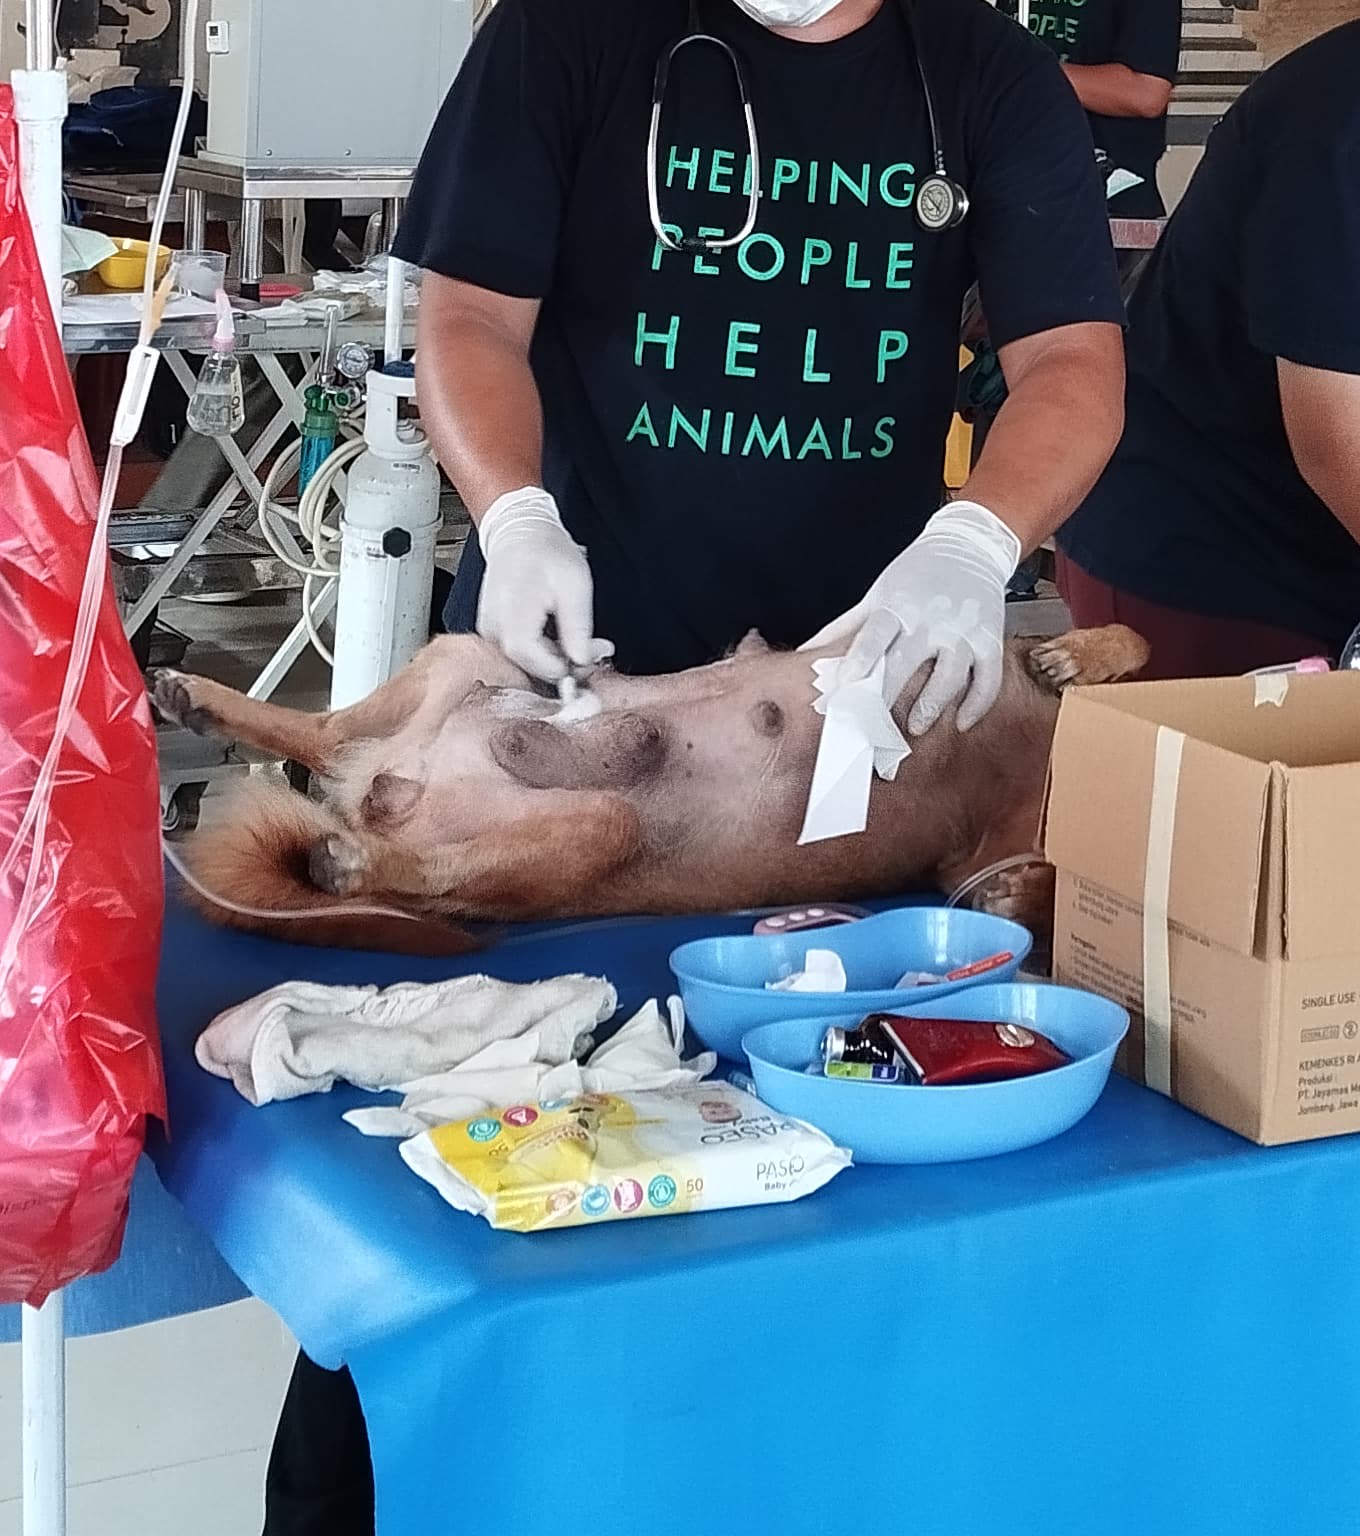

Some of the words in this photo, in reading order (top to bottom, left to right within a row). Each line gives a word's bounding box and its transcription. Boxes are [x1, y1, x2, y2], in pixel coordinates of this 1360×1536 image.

[666, 145, 915, 208] HELPING
[651, 223, 914, 290] PEOPLE
[634, 312, 909, 384] HELP
[625, 401, 896, 461] ANIMALS
[1301, 994, 1338, 1010] SINGLE
[1337, 991, 1356, 1005] USE
[1298, 1054, 1346, 1071] KEMENKES
[686, 1177, 704, 1193] 50
[764, 1181, 787, 1191] Baby
